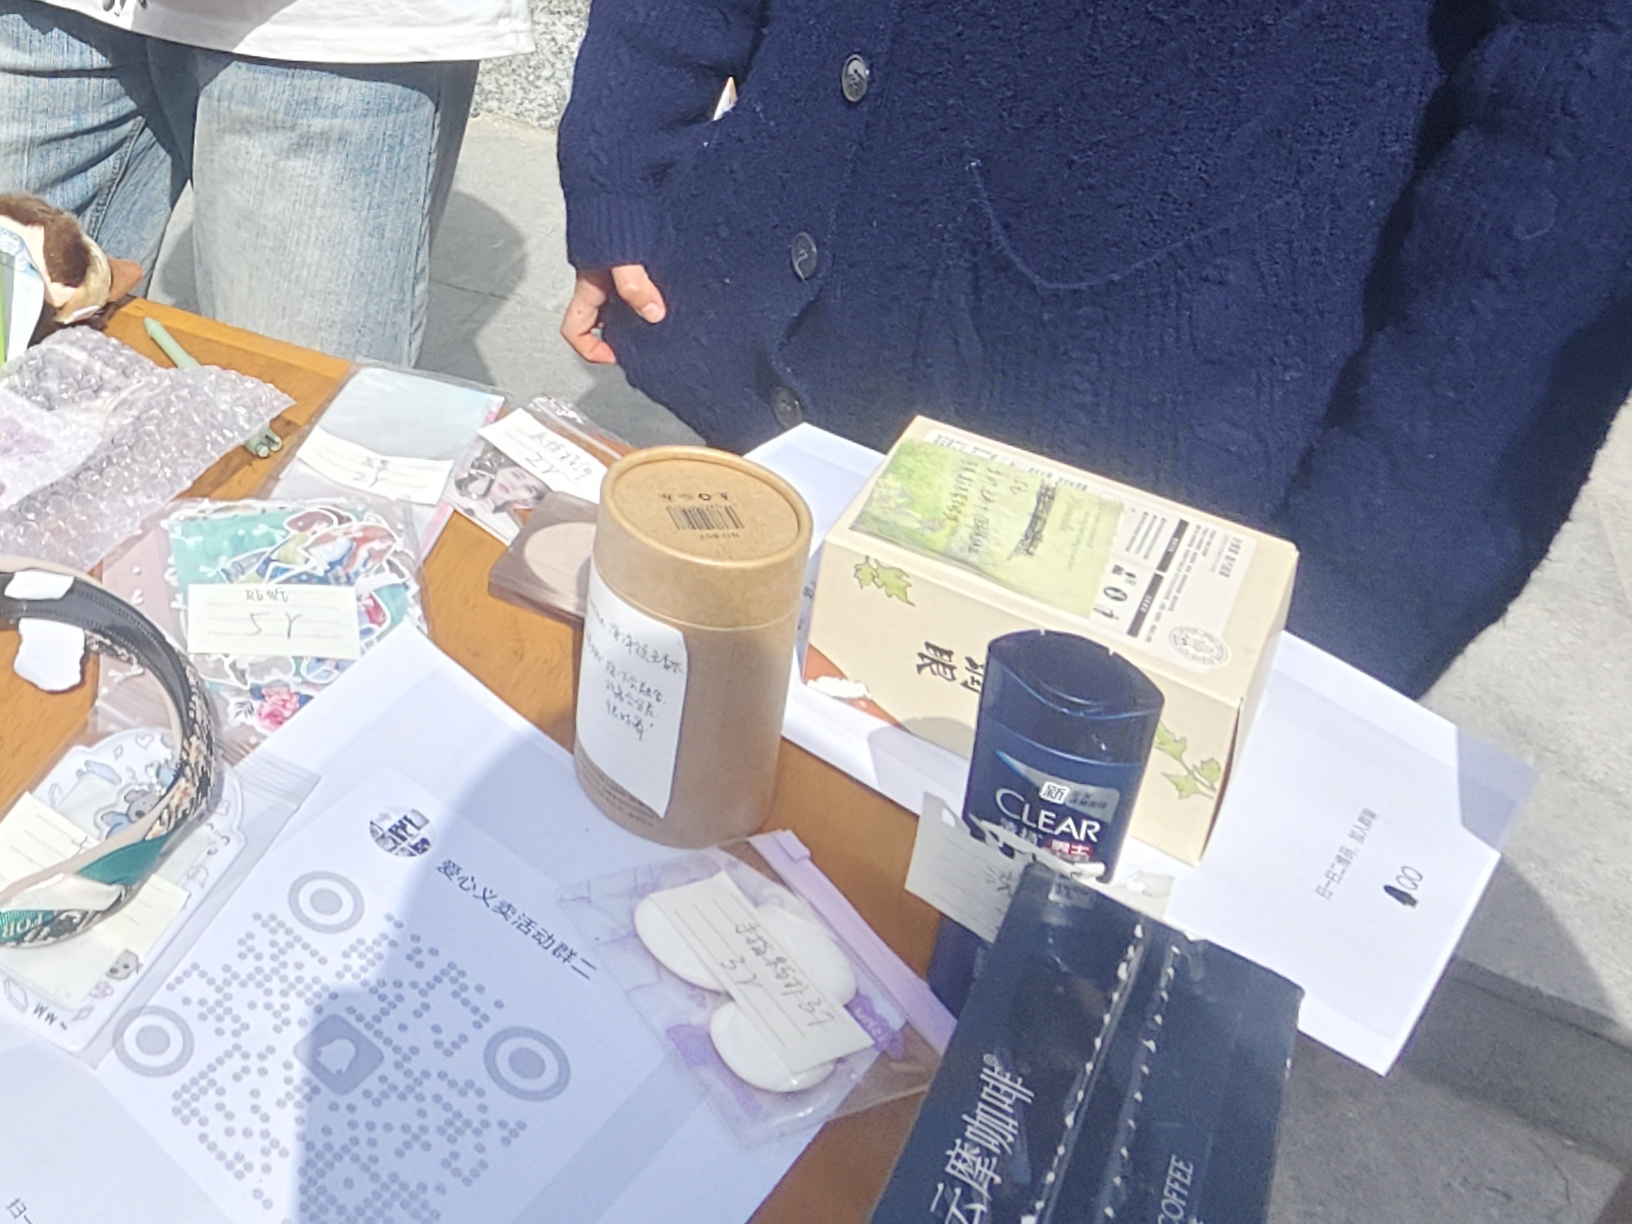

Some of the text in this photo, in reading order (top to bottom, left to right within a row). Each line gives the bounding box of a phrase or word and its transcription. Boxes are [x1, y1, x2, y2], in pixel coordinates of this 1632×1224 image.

[995, 788, 1101, 843] CLEAR
[1042, 783, 1066, 802] 新
[437, 859, 597, 980] 爱心义卖活动群二
